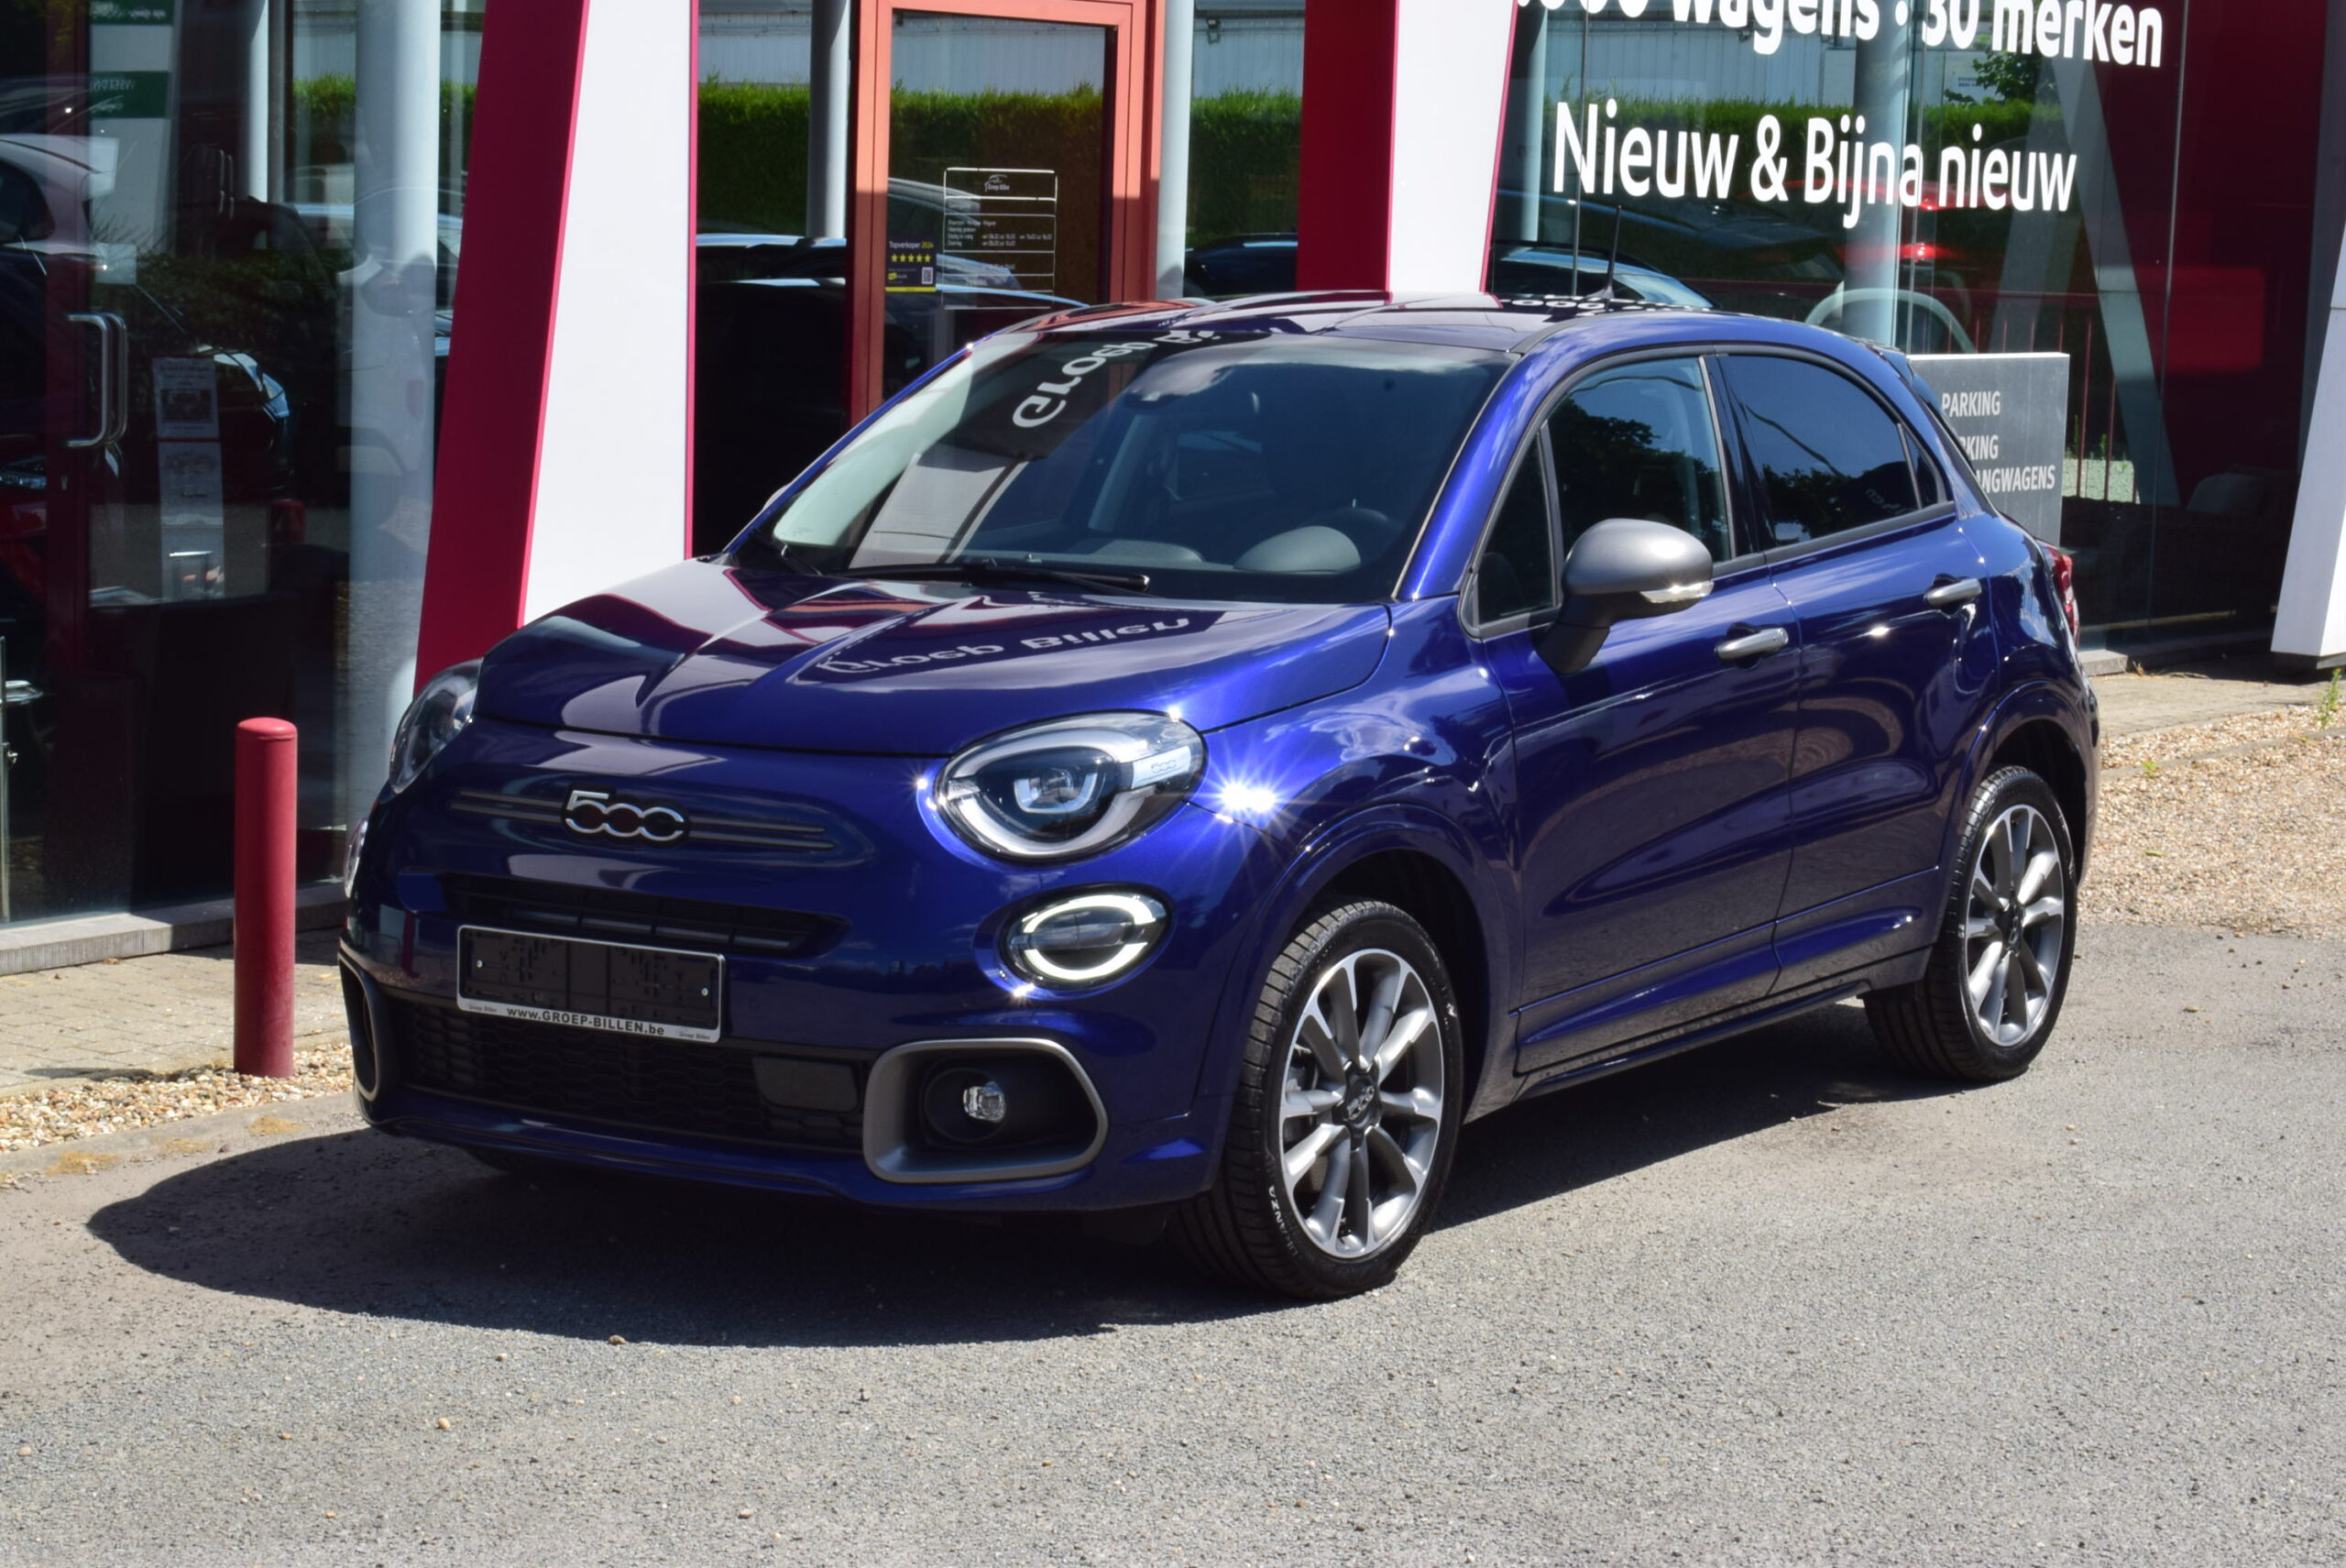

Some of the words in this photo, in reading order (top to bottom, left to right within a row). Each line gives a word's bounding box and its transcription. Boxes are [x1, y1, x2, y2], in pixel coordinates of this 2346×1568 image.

[1990, 0, 2163, 68] merken
[1553, 98, 1739, 199] Nieuw
[1750, 115, 1789, 202] &
[1803, 115, 1924, 229] Bijna
[1938, 123, 2077, 212] nieuw
[1942, 391, 2001, 417] PARKING
[565, 790, 685, 841] 500
[507, 1007, 664, 1036] www.GROEP-BILLEN.be
